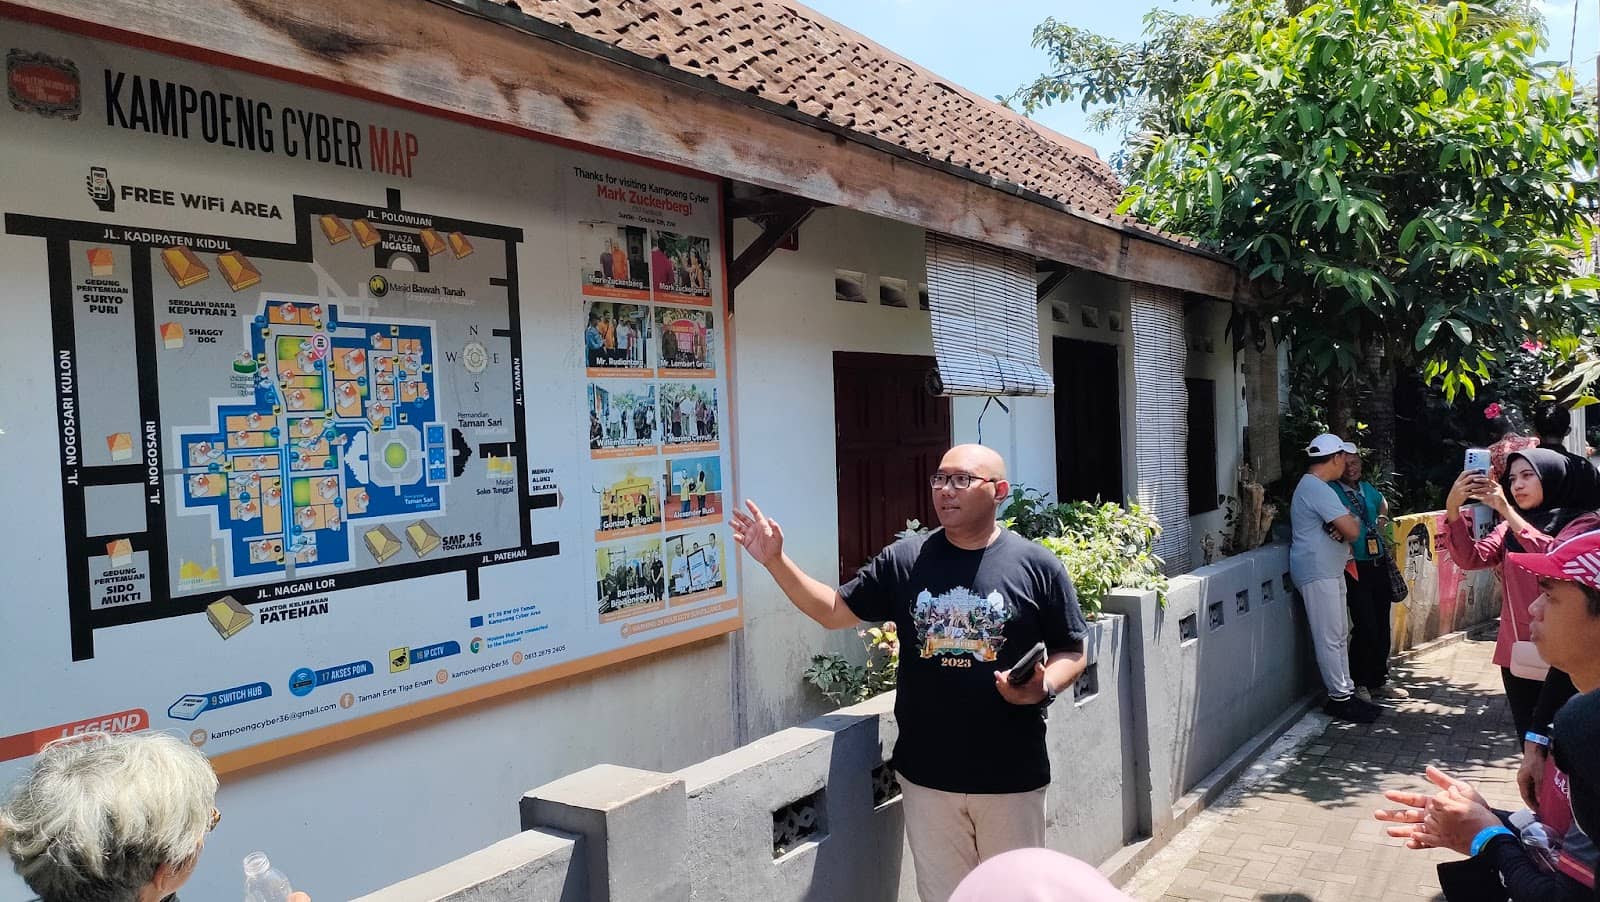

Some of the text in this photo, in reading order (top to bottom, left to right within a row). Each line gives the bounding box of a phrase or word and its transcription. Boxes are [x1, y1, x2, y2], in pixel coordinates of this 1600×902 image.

[104, 68, 274, 153] KAMPOENG
[282, 107, 363, 169] CYBER
[369, 124, 419, 178] MAP
[574, 167, 709, 205] Thanks for visiting Kampoeng Cyber
[120, 185, 282, 220] FREE WiFi AREA
[596, 184, 626, 201] Mark
[628, 190, 693, 216] Zuckerberg!
[381, 211, 432, 226] POLOWIJAN
[103, 229, 231, 250] JL. KADIPATEN KIDUL
[388, 233, 413, 243] PLAZA
[381, 241, 421, 253] NGASEM
[85, 279, 120, 287] GEDUNG
[76, 285, 128, 294] PERTEMUAN
[412, 283, 440, 295] Bawah
[441, 286, 465, 297] Tanah
[83, 294, 123, 304] SURYO
[89, 304, 118, 314] PURI
[168, 306, 237, 317] KEPUTRAN 2
[188, 328, 223, 337] SHAGGY
[469, 325, 478, 336] N
[445, 351, 458, 363] W
[493, 352, 499, 363] E
[513, 357, 521, 391] TAMAN
[474, 381, 480, 392] S
[60, 350, 78, 486] JL. NOGOSARI KULON
[458, 418, 502, 428] Taman Sari
[146, 421, 160, 504] JL. NOGOSARI
[442, 532, 482, 546] SMP 16
[494, 550, 527, 561] PATEHAN
[103, 567, 137, 577] GEDUNG
[94, 573, 145, 585] PERTEMUAN
[106, 583, 134, 594] SIDO
[256, 578, 336, 600] JL. NAGAN LOR
[101, 592, 141, 606] MUKTI
[259, 604, 286, 614] KANTOR
[260, 602, 329, 625] PATEHAN
[430, 646, 444, 657] CCTV
[941, 657, 972, 668] 2023
[331, 666, 352, 681] AKSES
[352, 663, 367, 675] POIN
[218, 690, 246, 704] SWITCH
[247, 686, 263, 698] HUB
[358, 679, 432, 703] Taman Erte Tiga Enam
